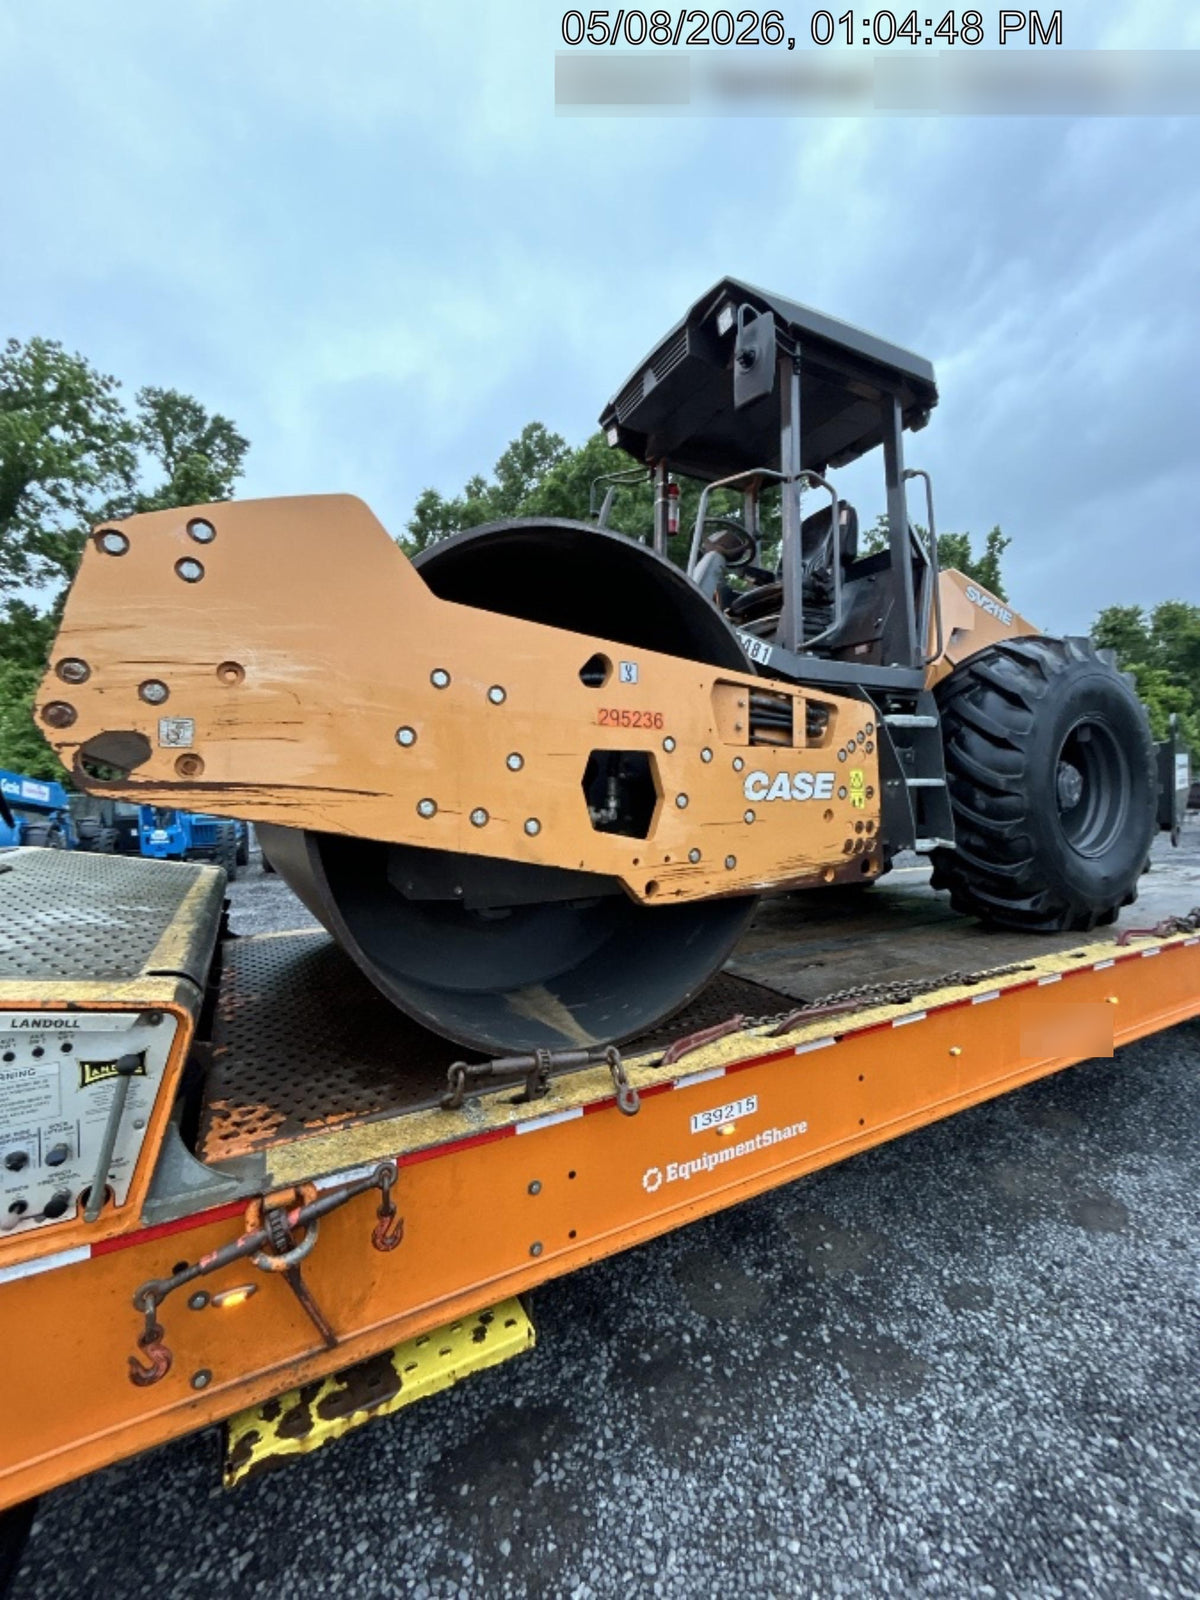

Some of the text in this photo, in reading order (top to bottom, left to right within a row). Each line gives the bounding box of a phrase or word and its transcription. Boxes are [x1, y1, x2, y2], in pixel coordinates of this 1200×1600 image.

[598, 708, 664, 730] 295236
[743, 769, 836, 802] CASE
[10, 1018, 80, 1029] LANDOLL
[693, 1096, 755, 1130] 139215
[666, 1121, 808, 1182] EquipmentShare
